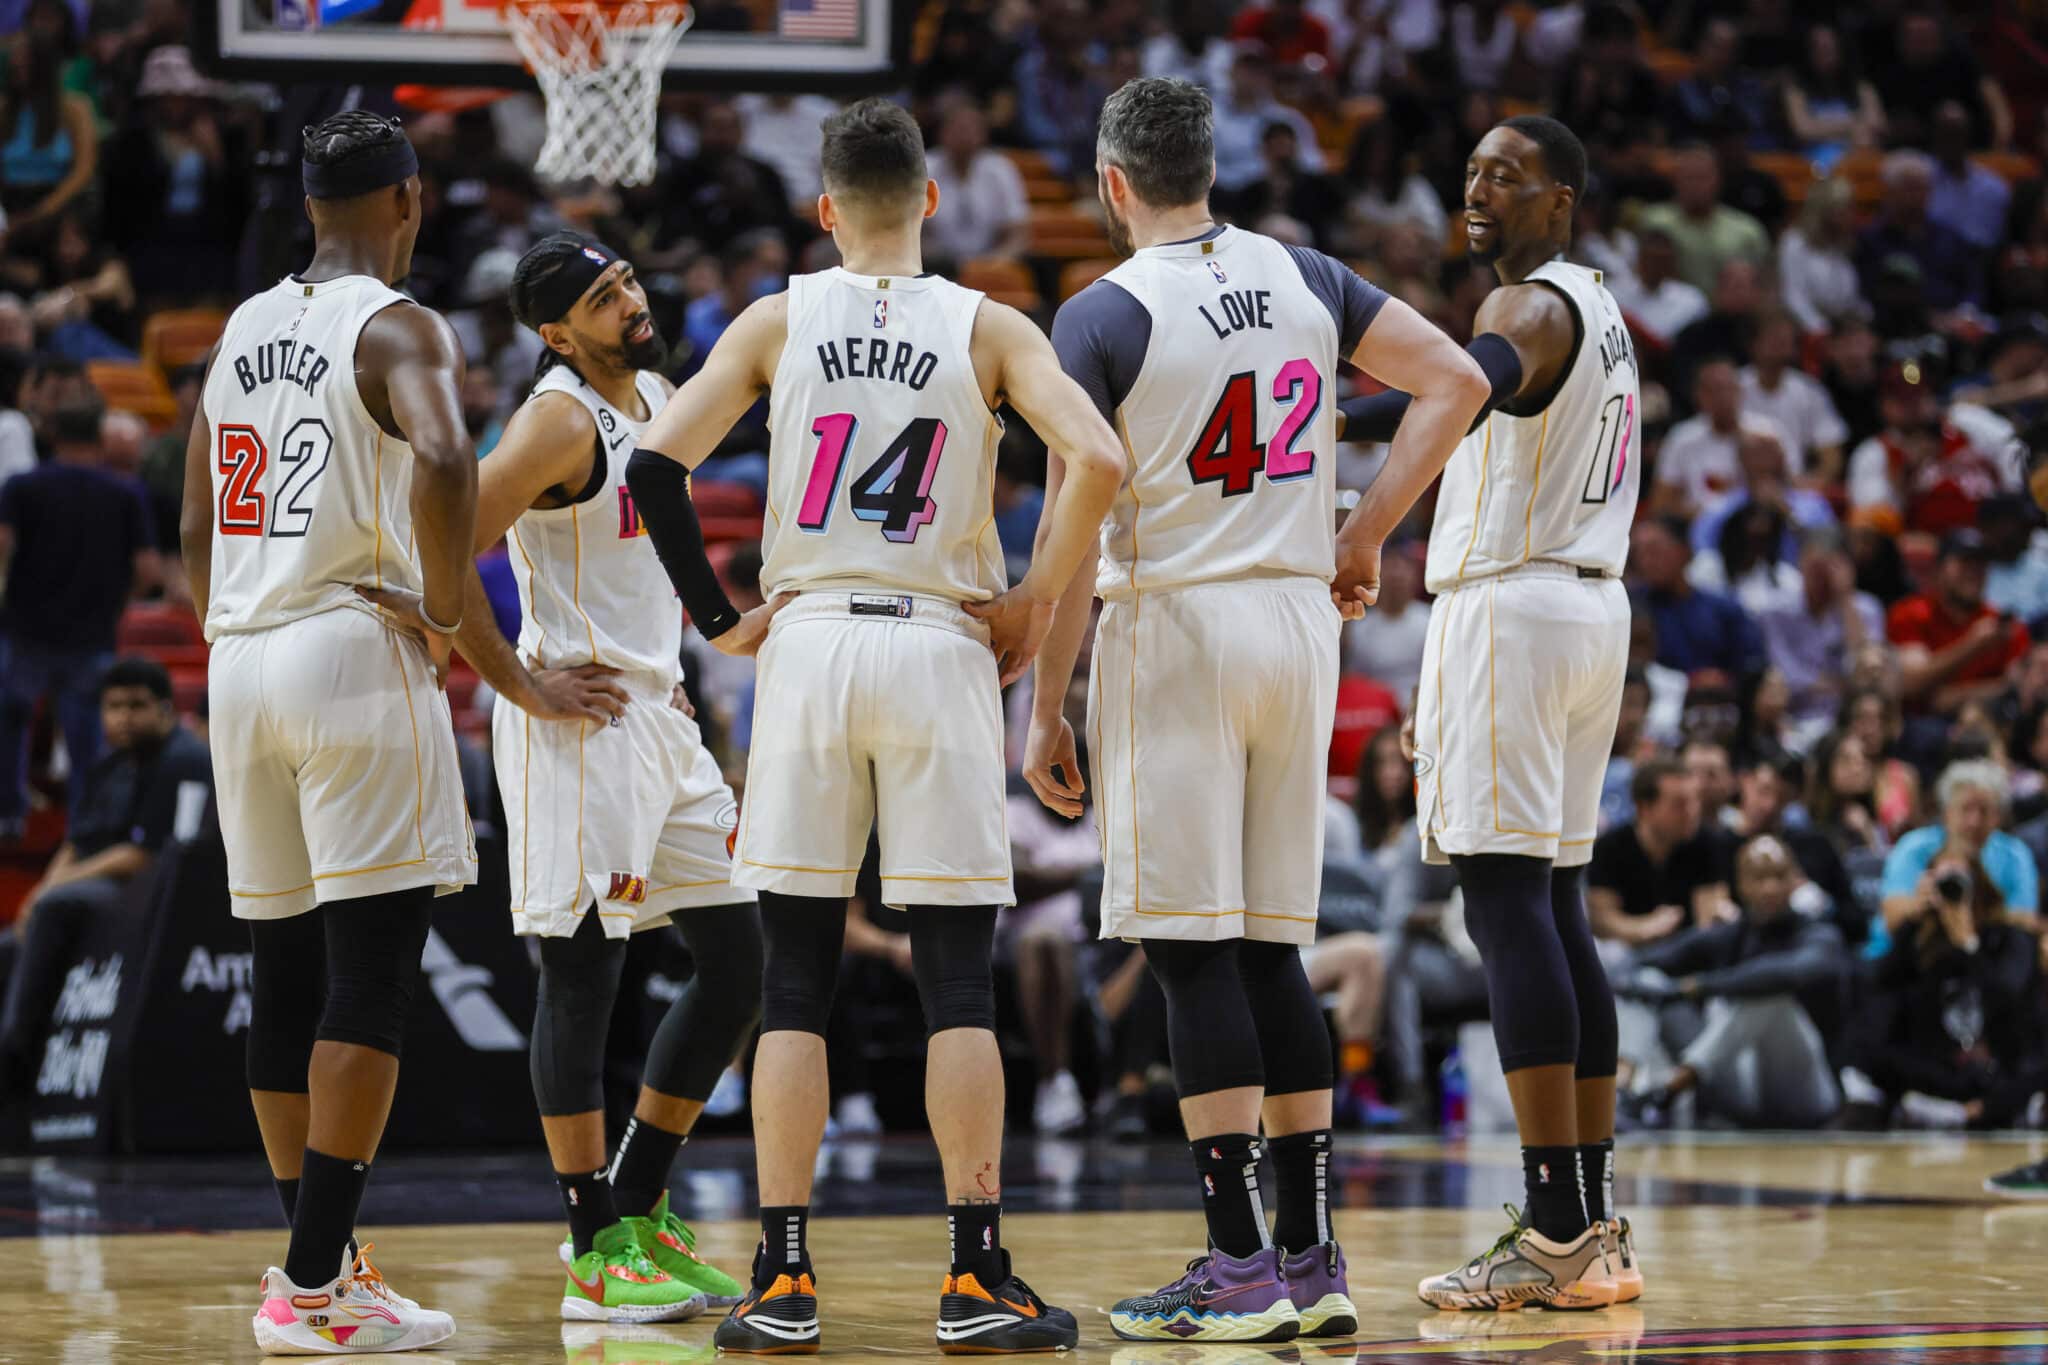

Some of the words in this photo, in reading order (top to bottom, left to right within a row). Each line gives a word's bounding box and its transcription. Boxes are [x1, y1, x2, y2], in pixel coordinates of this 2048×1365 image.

[1198, 291, 1273, 340] LOVE
[234, 339, 329, 396] BUTLER
[817, 338, 939, 391] HERRO
[1186, 358, 1325, 498] 42
[218, 418, 333, 537] 22
[796, 412, 948, 544] 14
